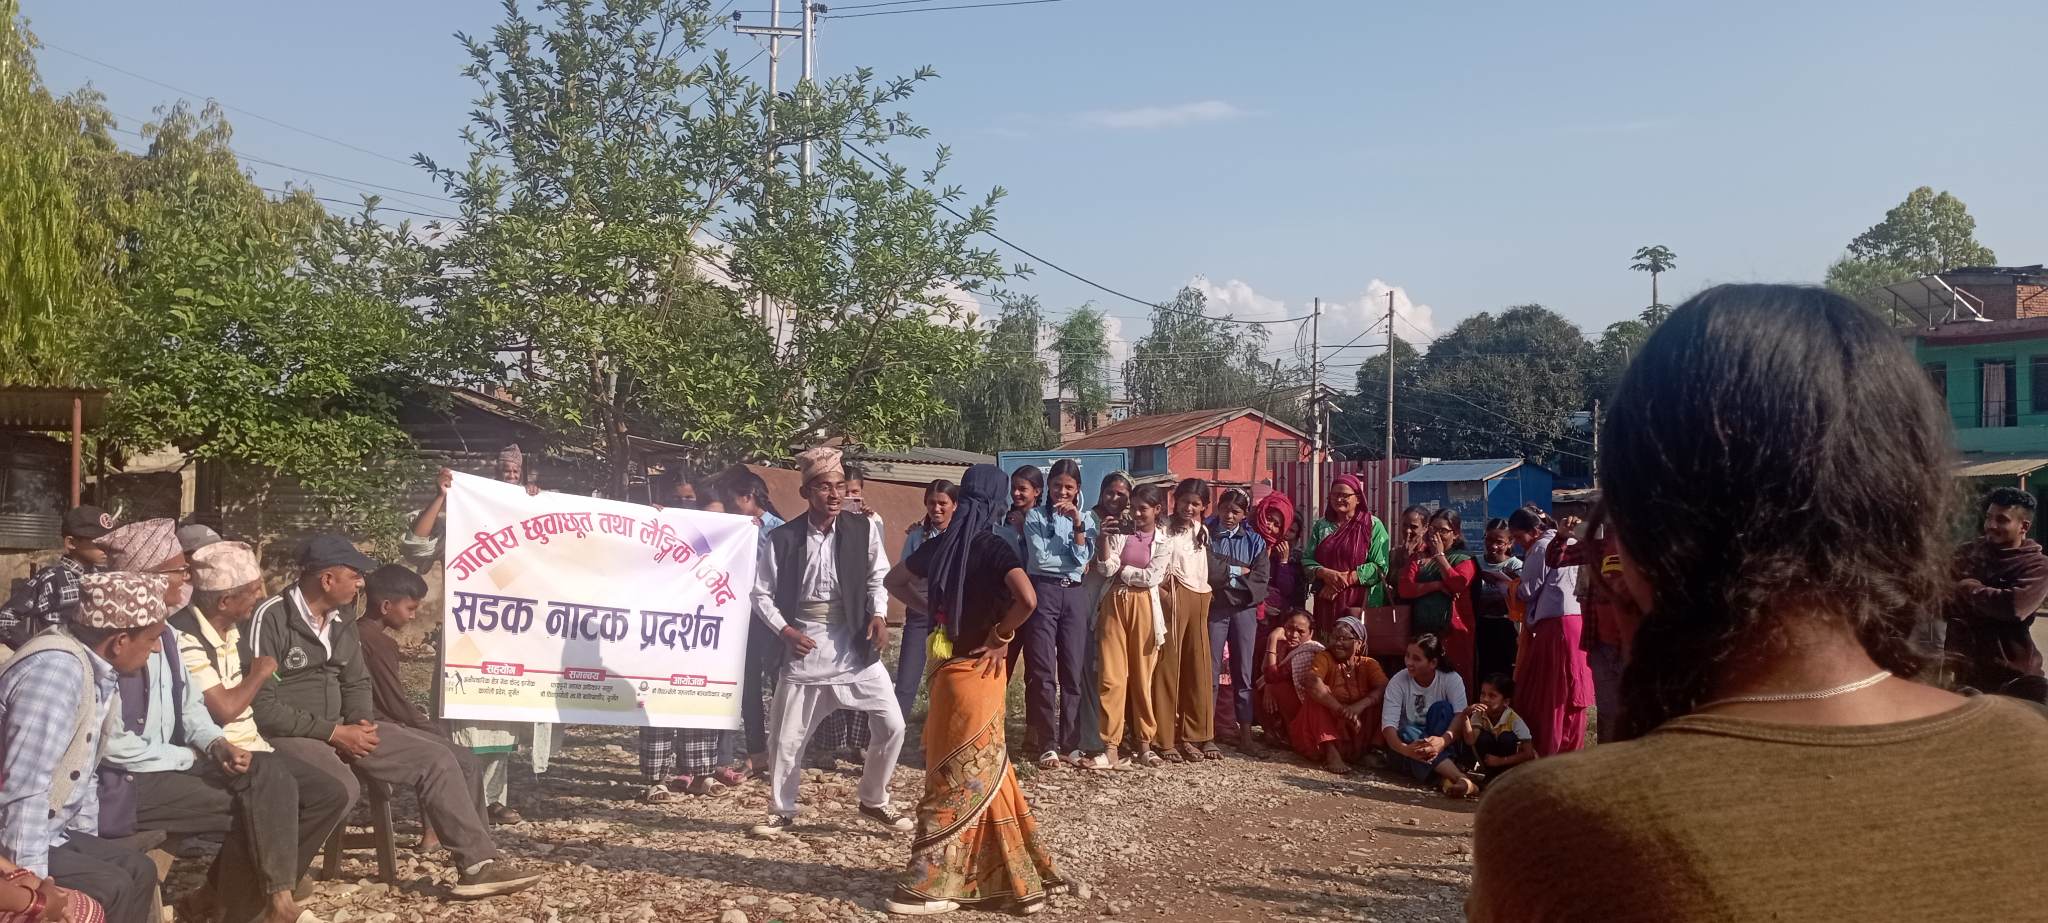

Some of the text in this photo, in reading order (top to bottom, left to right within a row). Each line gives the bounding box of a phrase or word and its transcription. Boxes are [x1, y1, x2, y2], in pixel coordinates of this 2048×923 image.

[446, 525, 519, 580] जातीय
[598, 512, 635, 537] तथा
[640, 518, 695, 563] लैङ्गिक
[452, 591, 724, 651] सडक नाटक प्रदर्शन
[486, 664, 517, 675] सहयोग
[568, 670, 601, 680] समन्वय
[672, 675, 705, 686] आयोजक
